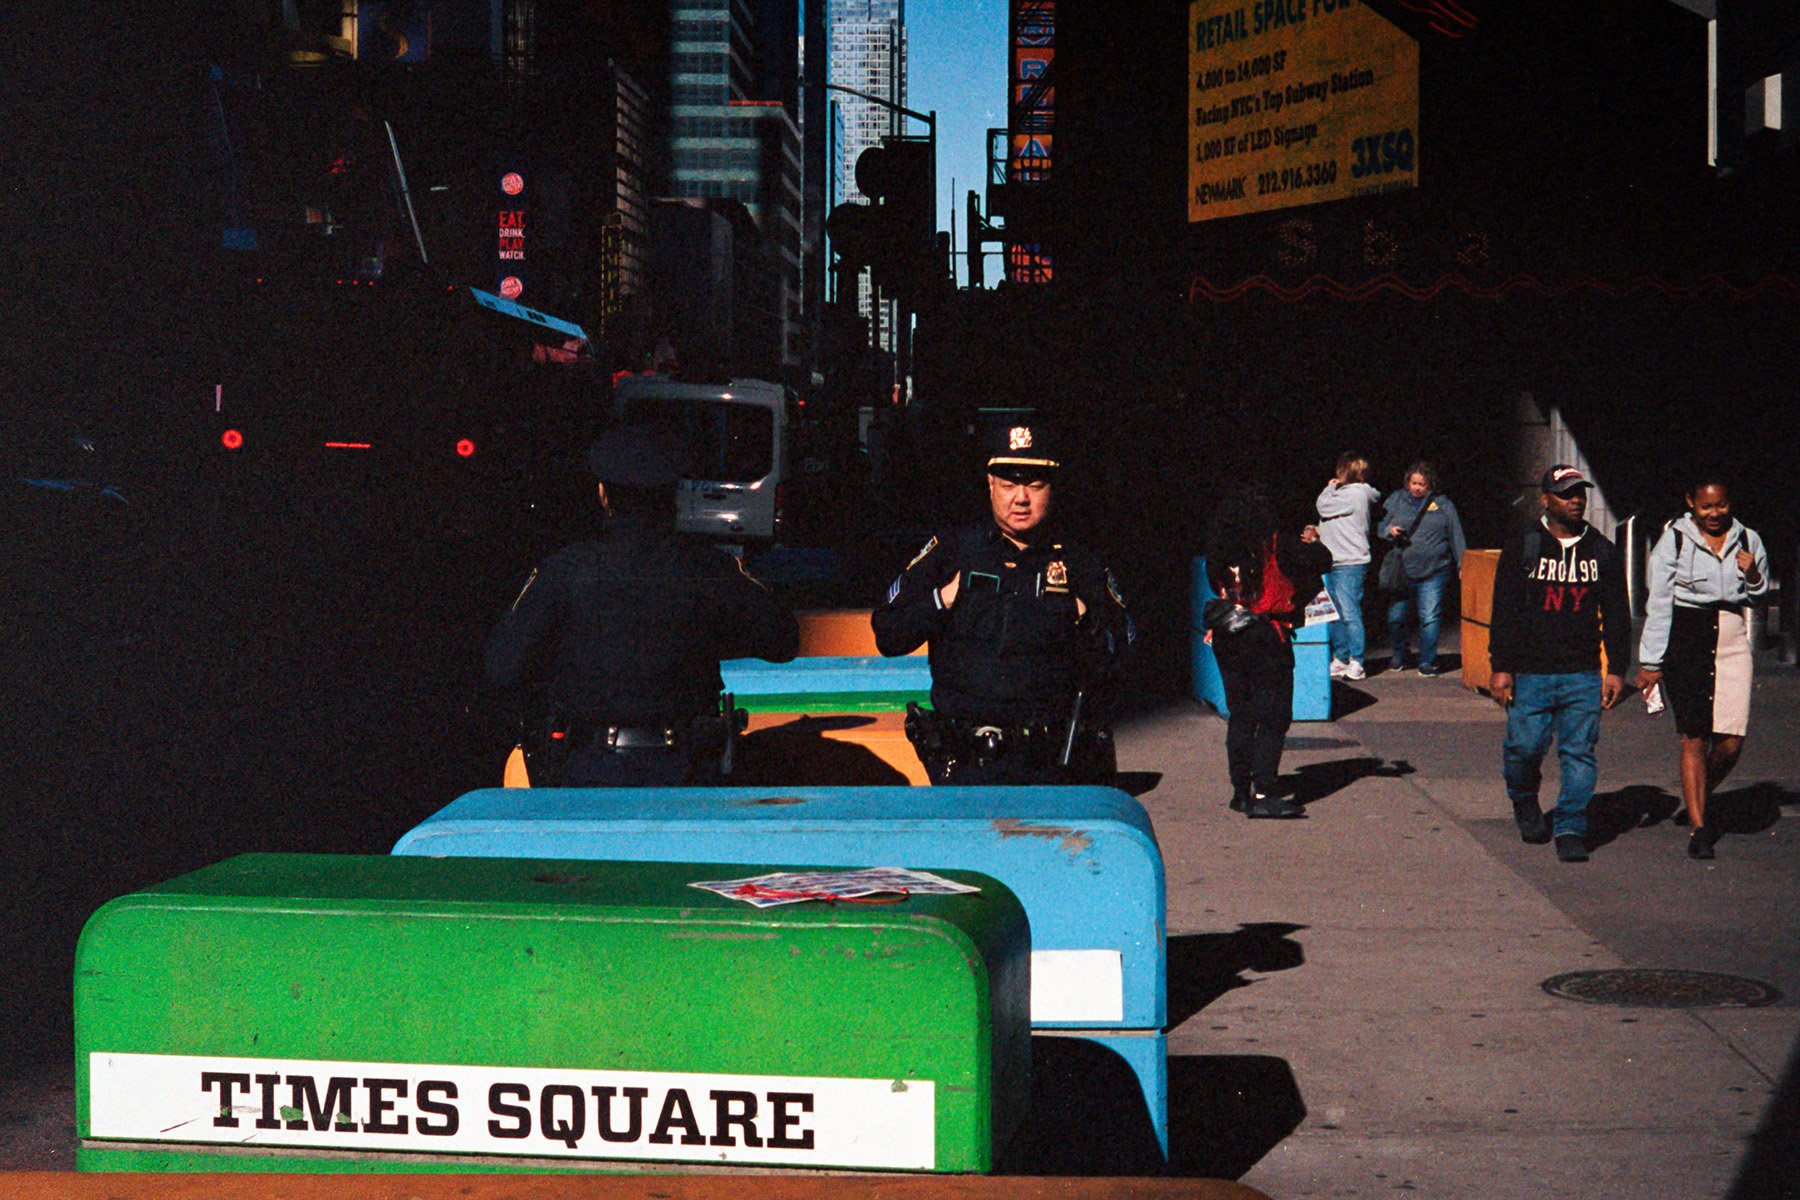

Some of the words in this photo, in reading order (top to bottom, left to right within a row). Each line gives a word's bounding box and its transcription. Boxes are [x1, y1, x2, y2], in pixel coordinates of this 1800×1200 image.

[1196, 9, 1248, 51] RETAIL
[1254, 0, 1305, 35] SPACE
[1225, 67, 1235, 82] to
[1273, 50, 1287, 71] SF
[1196, 104, 1229, 126] Facing
[1231, 95, 1262, 118] NYC's
[1263, 90, 1283, 113] Top
[1286, 79, 1328, 106] Subway
[1331, 68, 1373, 94] Station
[1224, 137, 1236, 156] SF
[1238, 134, 1249, 153] of
[1250, 127, 1271, 151] LED
[1274, 122, 1318, 149] Signage
[1351, 128, 1414, 179] 3XSQ
[1258, 160, 1337, 195] 212.916.3360
[1543, 585, 1589, 612] NY
[201, 1071, 459, 1137] TIMES
[487, 1082, 814, 1149] SQUARE
